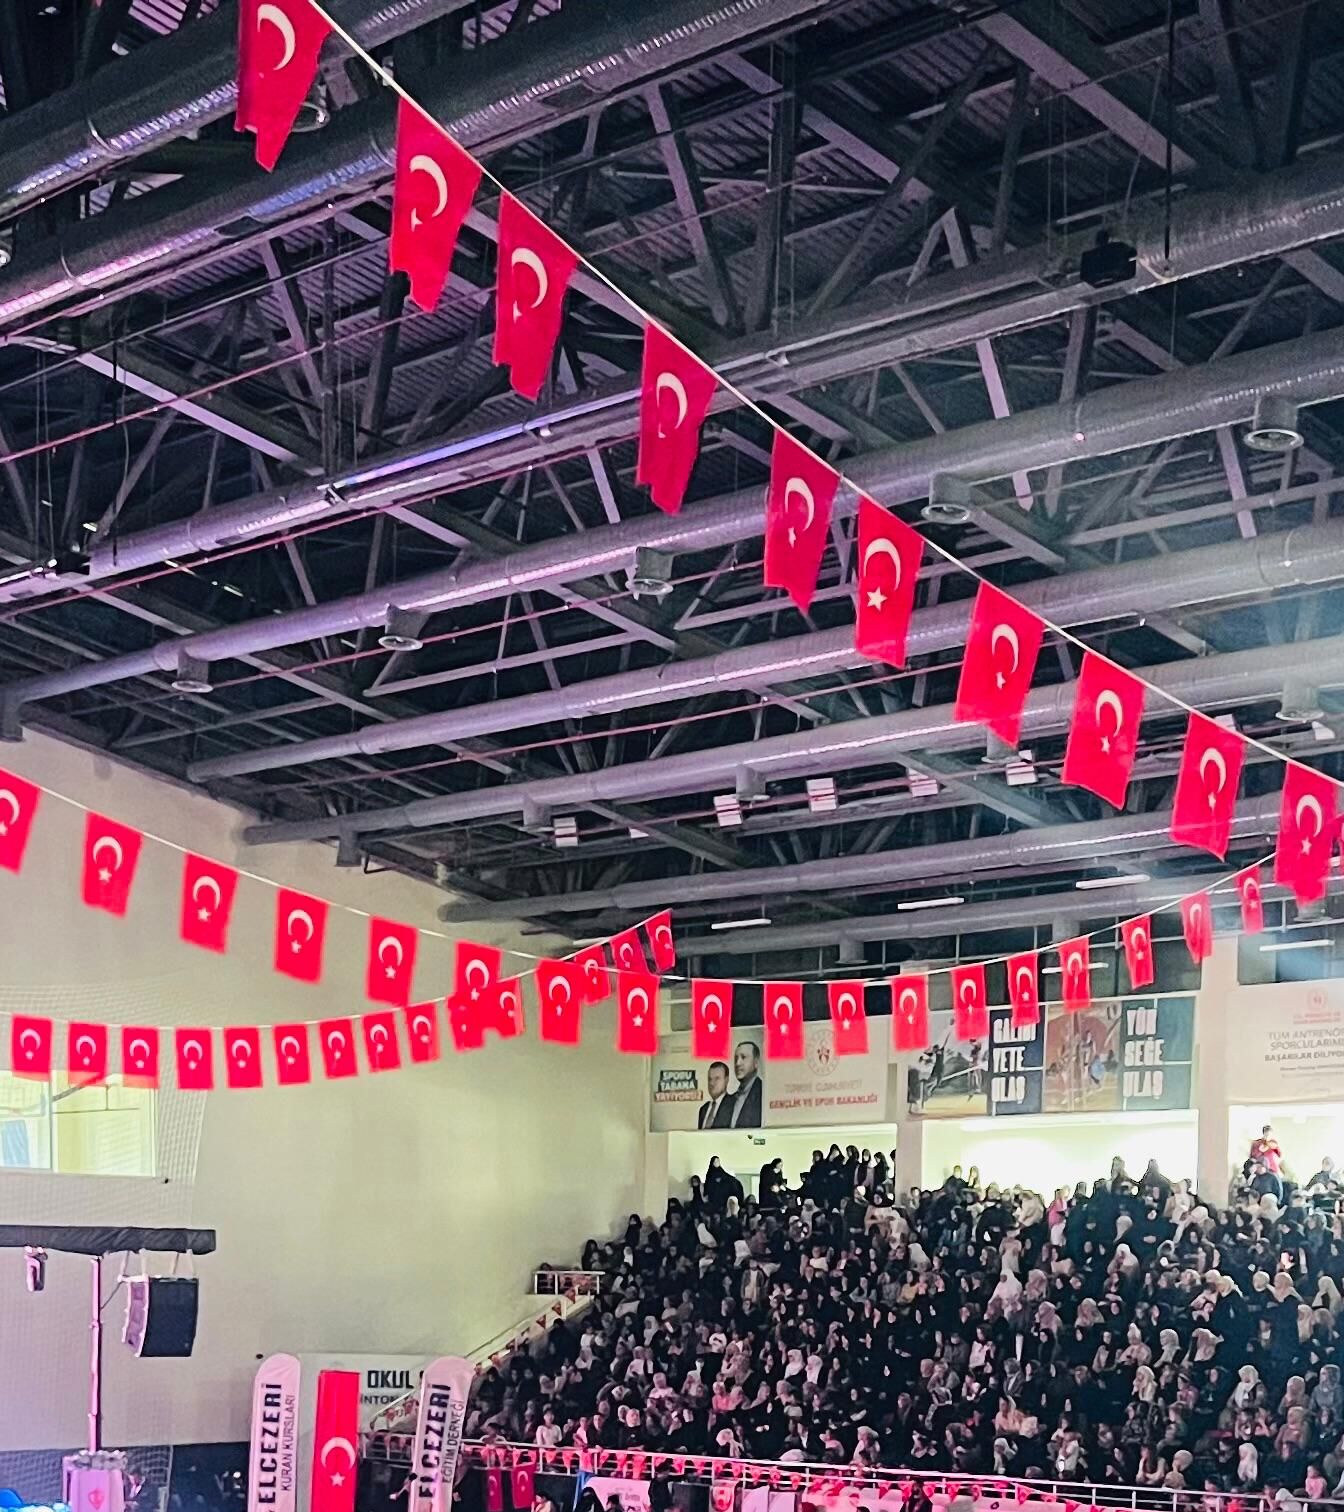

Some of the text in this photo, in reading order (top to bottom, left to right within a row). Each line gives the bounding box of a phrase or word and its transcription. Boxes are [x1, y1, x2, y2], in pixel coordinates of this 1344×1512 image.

[992, 1046, 1026, 1073] YETE
[1124, 1037, 1165, 1067] SEĞE
[991, 1076, 1026, 1104] ULAŞ
[1122, 1071, 1164, 1100] ULAŞ
[367, 1368, 416, 1390] OKUL
[258, 1383, 283, 1504] ELCEZERİ
[280, 1393, 296, 1493] KURAN KURSLARI
